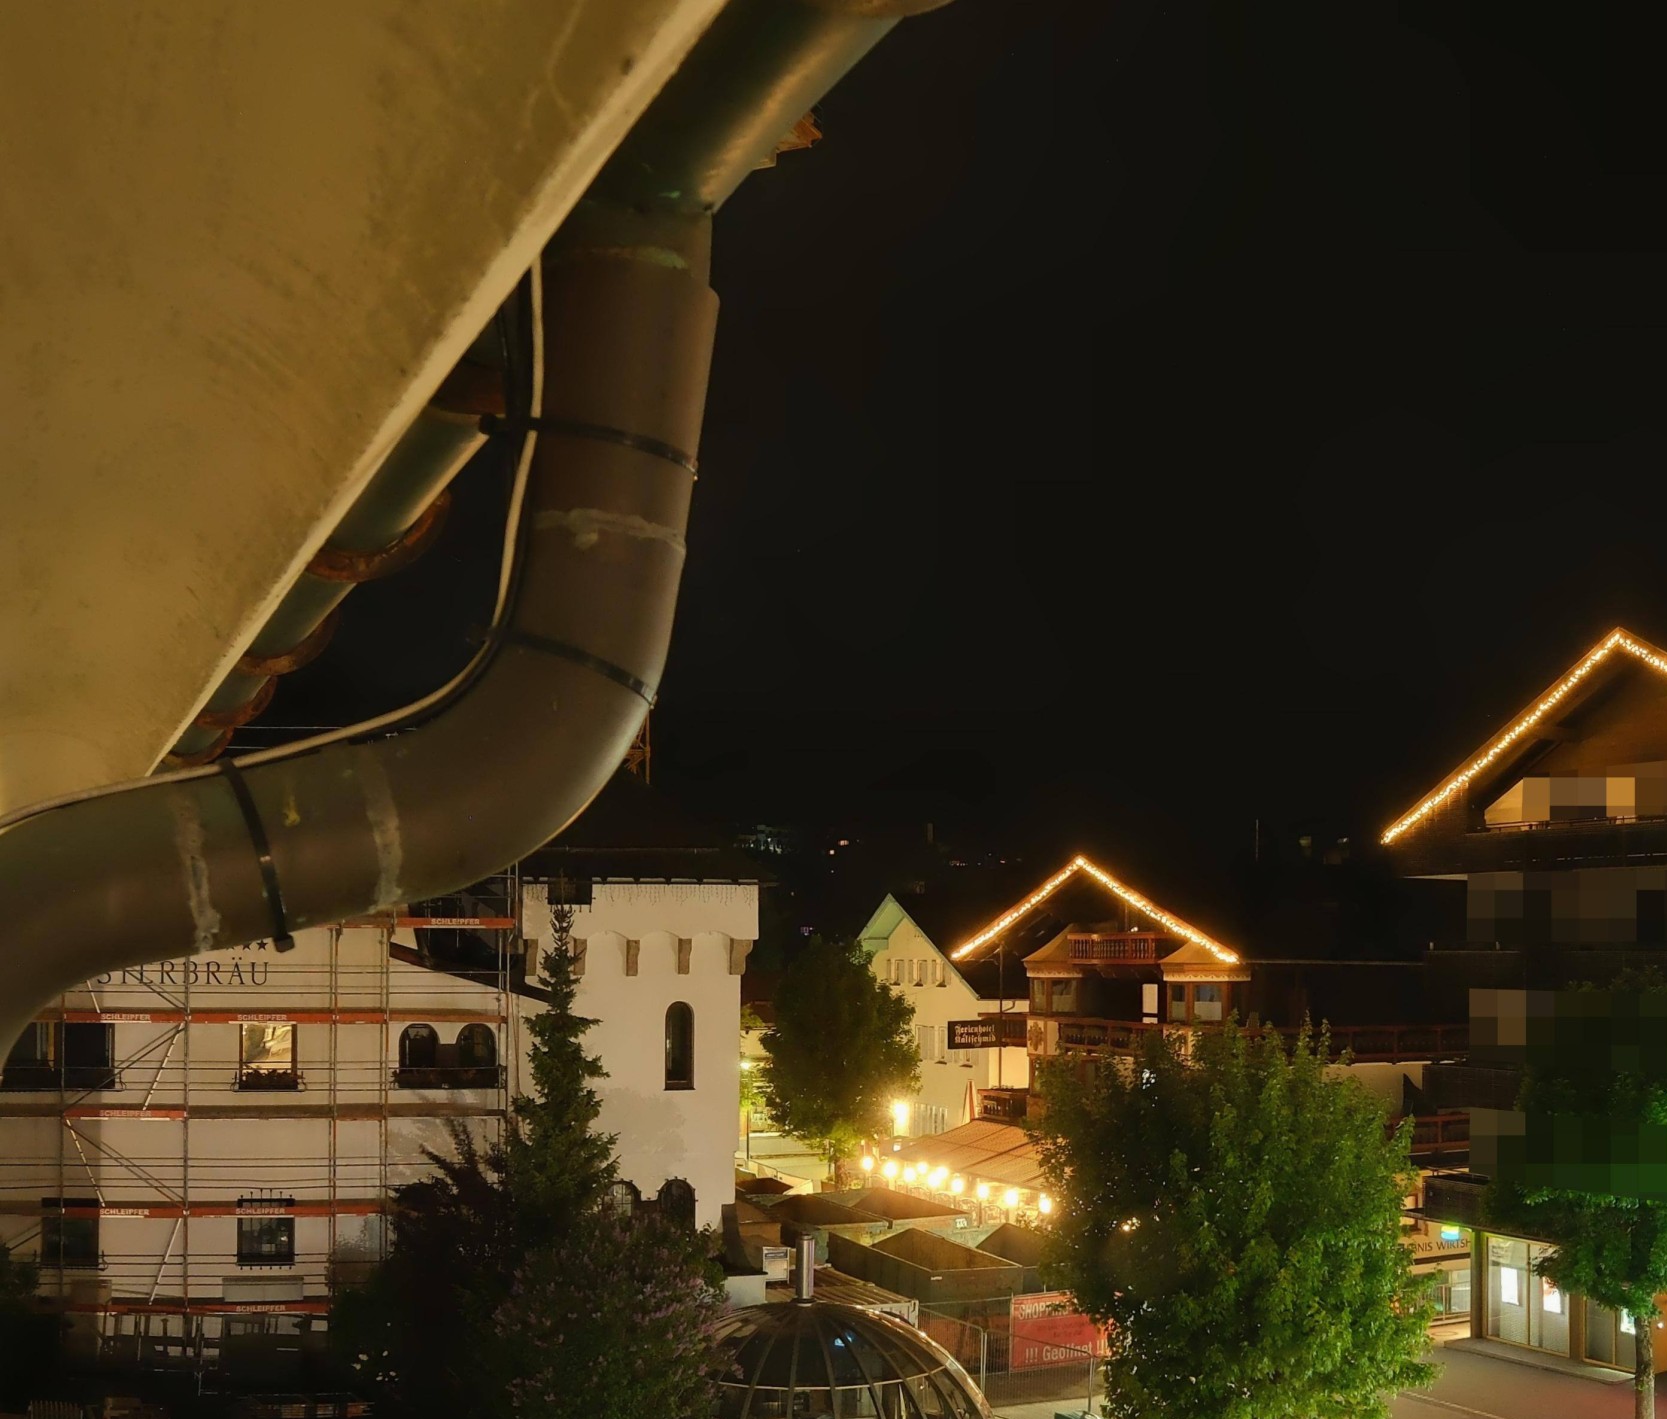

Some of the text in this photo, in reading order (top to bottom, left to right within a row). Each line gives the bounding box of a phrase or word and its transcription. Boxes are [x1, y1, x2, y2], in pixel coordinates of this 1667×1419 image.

[431, 918, 480, 926] SCHLEIPFER
[101, 1013, 151, 1021] SCHLEIPFER
[237, 1013, 287, 1022] SCHLEIPFER
[954, 1023, 996, 1034] Ferienhotel
[99, 1109, 152, 1118] SCHLEIPFER
[99, 1208, 150, 1217] SCHLEIPFER
[235, 1207, 287, 1216] SCHLEIPFER
[235, 1305, 287, 1313] SCHLEIPFER
